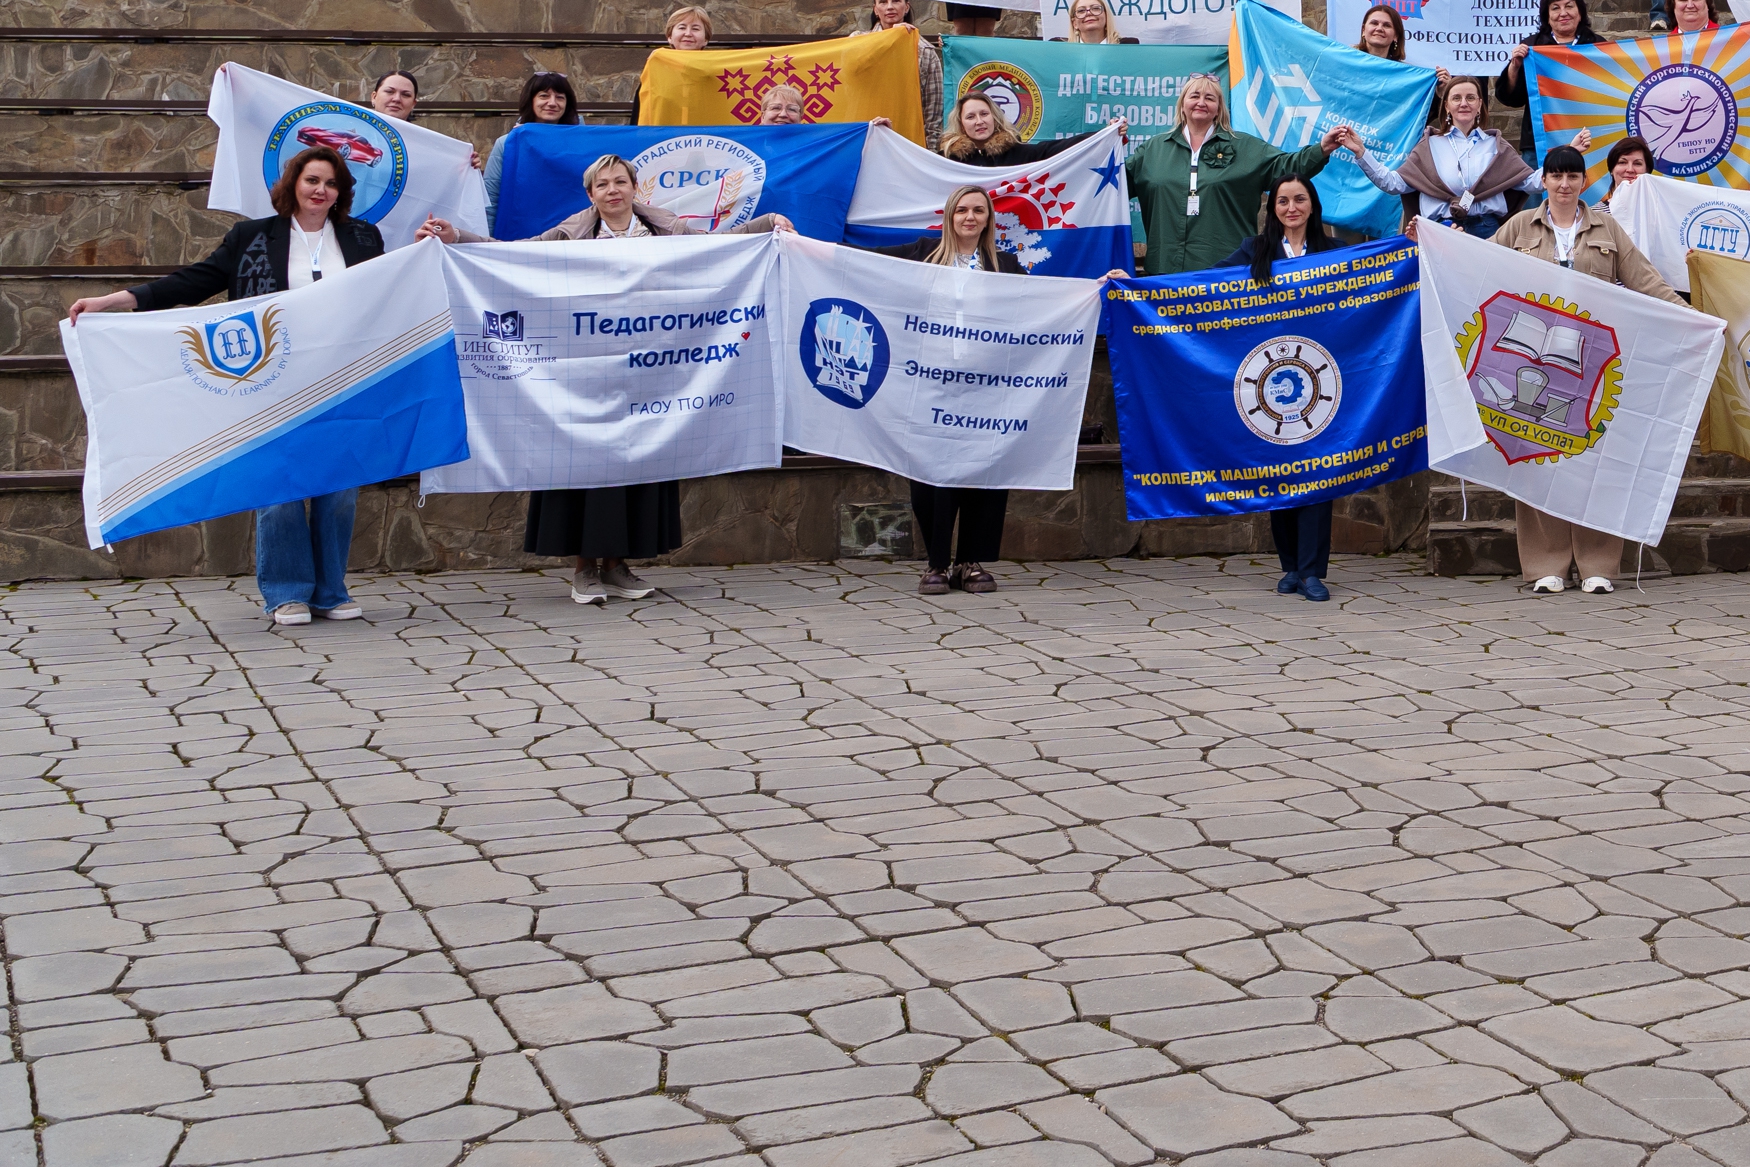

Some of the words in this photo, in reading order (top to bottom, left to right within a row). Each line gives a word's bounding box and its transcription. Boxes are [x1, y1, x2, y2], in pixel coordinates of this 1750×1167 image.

[1473, 15, 1540, 27] ТЕХНИК
[969, 64, 997, 80] БАЗОВЫЙ
[999, 64, 1040, 103] МЕДИЦИНСКИЙ
[1085, 103, 1177, 126] БАЗОВЫ
[1645, 66, 1735, 151] торгово-технологический
[268, 104, 341, 152] ТЕХНИКУМ
[635, 137, 702, 175] ОГРАДСКИЙ
[1385, 142, 1394, 151] И
[1677, 139, 1702, 148] ГБПОУ
[1672, 151, 1723, 175] техникум
[1680, 217, 1690, 246] КОЛЛЕДЖ
[1687, 200, 1726, 217] ЭКОНОМИКИ,
[1697, 224, 1740, 253] ДГТУ
[1107, 284, 1207, 302] ФЕДЕРАЛЬНОЕ
[1157, 290, 1296, 318] ОБРАЗОВАТЕЛЬНОЕ
[1299, 269, 1394, 299] УЧРЕЖДЕНИЕ
[573, 303, 765, 336] Педагогически
[1132, 322, 1193, 335] среднего
[1196, 301, 1336, 332] профессионального
[1339, 281, 1420, 309] образования
[280, 327, 292, 356] DOING
[904, 315, 1084, 345] Невинномысский
[462, 341, 543, 355] ИНСТИТУТ
[497, 355, 557, 364] образования
[629, 342, 740, 368] колледж
[180, 347, 228, 396] ДЕЛАЯ-ПОЗНАЮ
[278, 358, 289, 370] BY
[470, 362, 491, 378] город
[492, 365, 534, 381] Севастополь
[822, 357, 859, 381] НЭТ
[905, 360, 1069, 388] Энергетический
[239, 370, 281, 396] LEARNING
[630, 399, 671, 415] ГАОУ
[678, 395, 703, 411] ПО
[709, 392, 735, 407] ИРО
[931, 408, 1028, 434] Техникум
[1133, 470, 1217, 486] "КОЛЛЕДЖ
[1221, 446, 1374, 482] МАШИНОСТРОЕНИЯ
[1377, 442, 1388, 454] И
[1206, 489, 1255, 503] имени
[1259, 484, 1274, 497] С.
[1278, 458, 1395, 497] Орджоникидзе"
